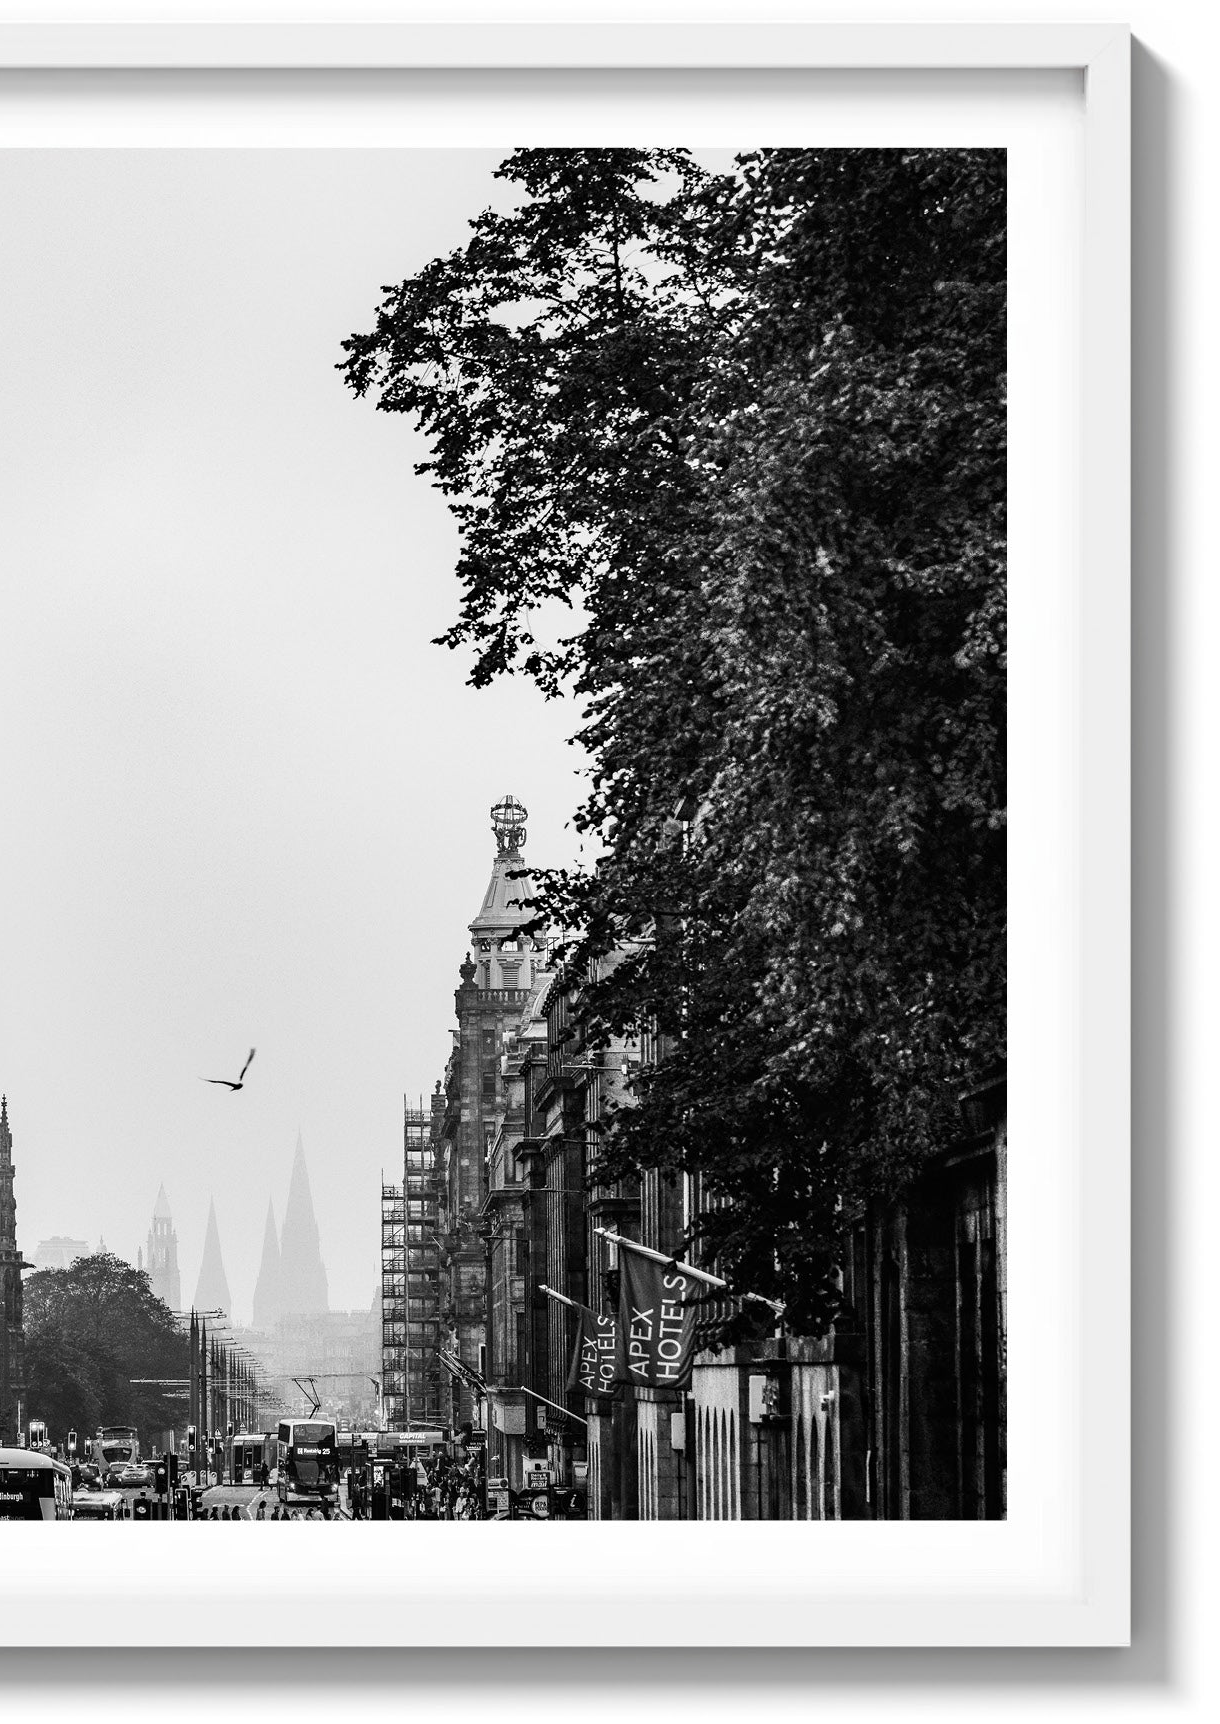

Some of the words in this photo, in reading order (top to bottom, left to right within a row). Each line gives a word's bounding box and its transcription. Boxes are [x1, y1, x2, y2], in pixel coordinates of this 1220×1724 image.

[579, 1335, 598, 1390] APEX
[597, 1315, 615, 1393] HOTELS
[628, 1306, 654, 1378] APEX
[656, 1275, 687, 1379] HOTELS
